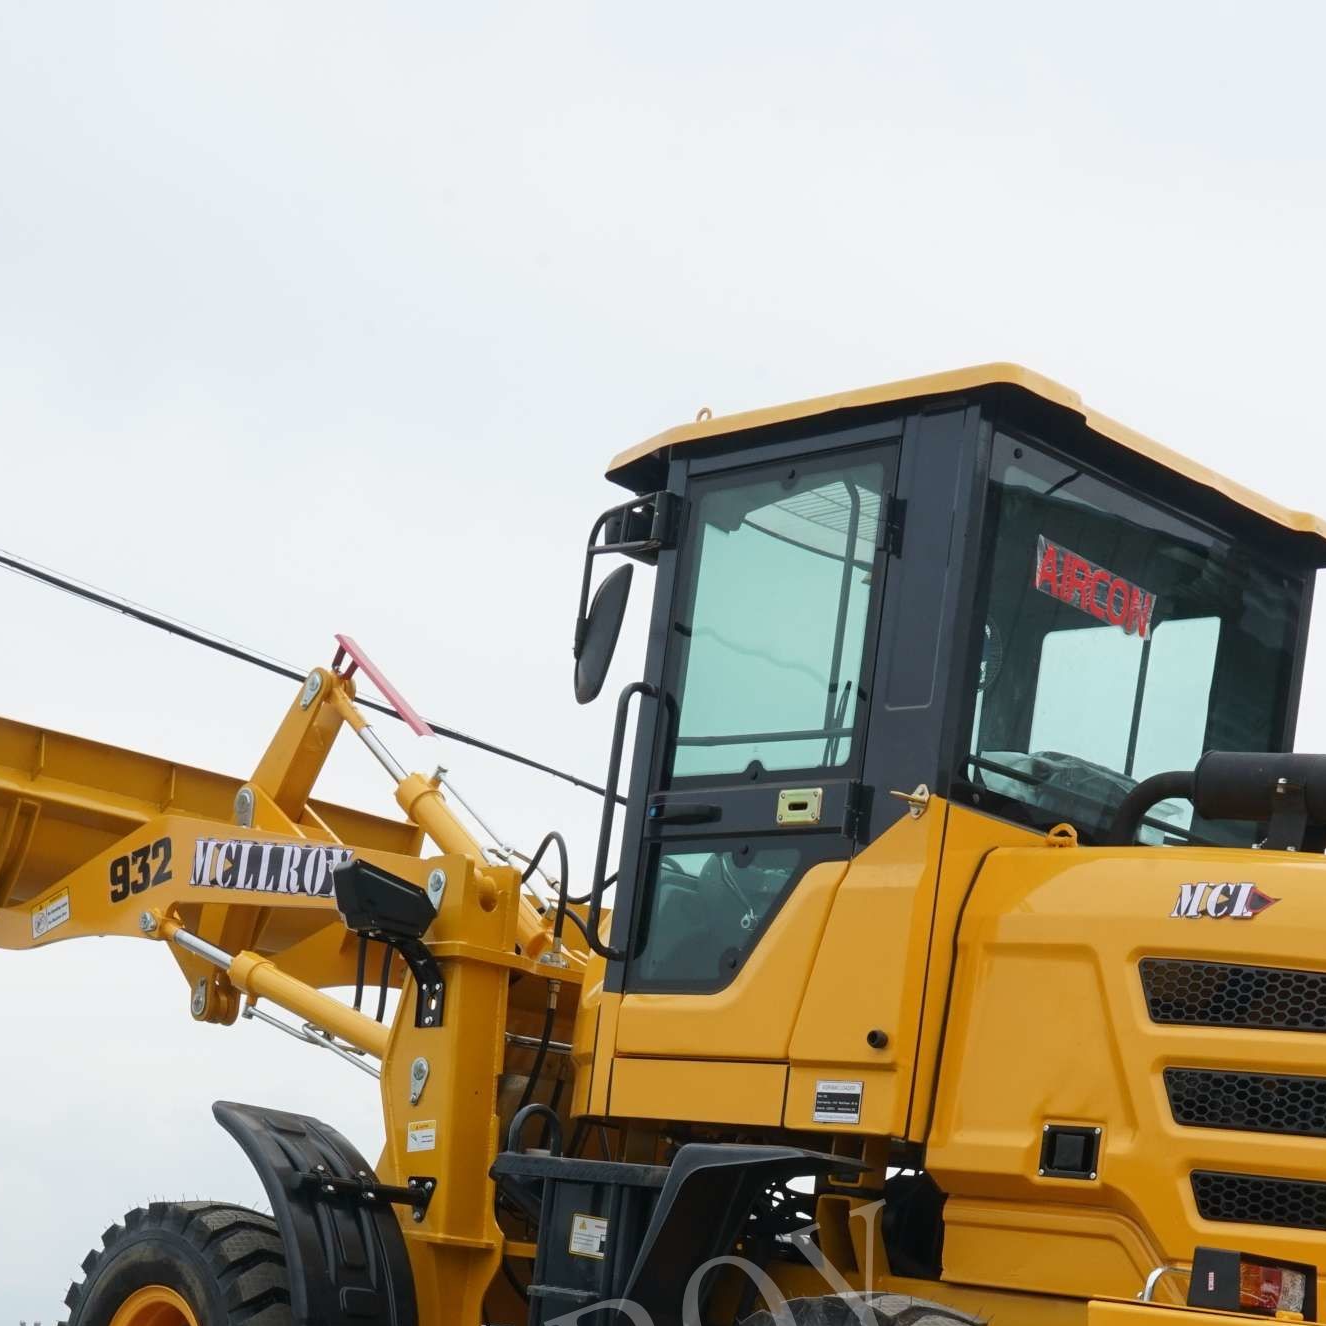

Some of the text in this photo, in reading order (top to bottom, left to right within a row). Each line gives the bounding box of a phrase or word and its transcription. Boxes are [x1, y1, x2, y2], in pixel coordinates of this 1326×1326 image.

[1038, 544, 1152, 638] AIRCON
[109, 837, 173, 903] 932
[1171, 882, 1255, 918] MCL
